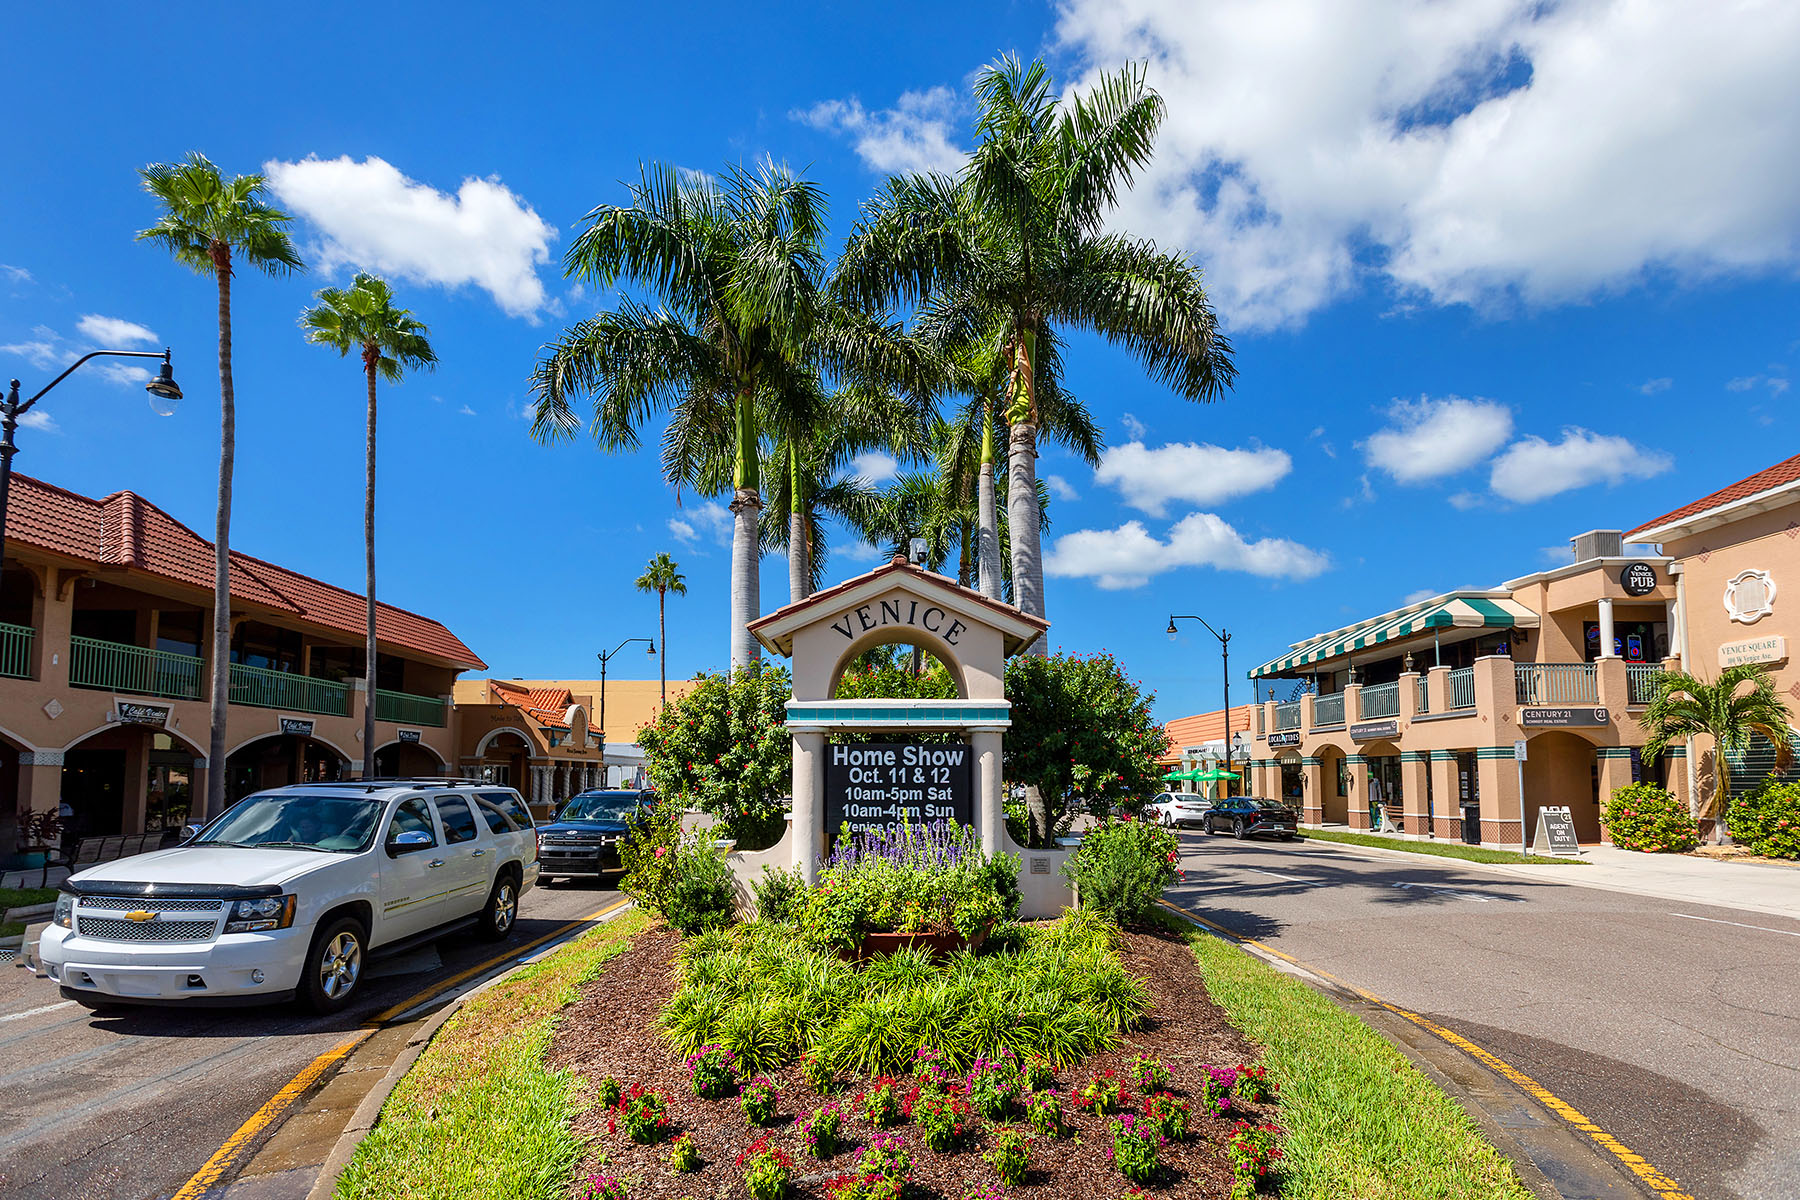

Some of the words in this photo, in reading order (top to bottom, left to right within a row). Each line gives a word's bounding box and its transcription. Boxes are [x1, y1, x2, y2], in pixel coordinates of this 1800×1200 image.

[1630, 576, 1655, 587] PUB
[830, 599, 967, 646] VENICE
[1721, 644, 1747, 655] VENICE
[1748, 639, 1777, 652] SQUARE
[1525, 710, 1562, 718] CENTURY
[1563, 710, 1572, 718] 21
[1597, 709, 1606, 718] 21
[1268, 735, 1283, 743] LOCAL
[1285, 733, 1299, 742] TIDES
[833, 745, 896, 766] Home
[902, 745, 964, 766] Show
[849, 767, 883, 784] Oct.
[888, 767, 907, 784] 11
[912, 767, 925, 784] &
[930, 767, 950, 784] 12
[844, 787, 923, 804] 10am-5pm
[927, 787, 953, 801] Sat
[842, 803, 920, 821] 10am-4pm
[924, 803, 955, 818] Sun
